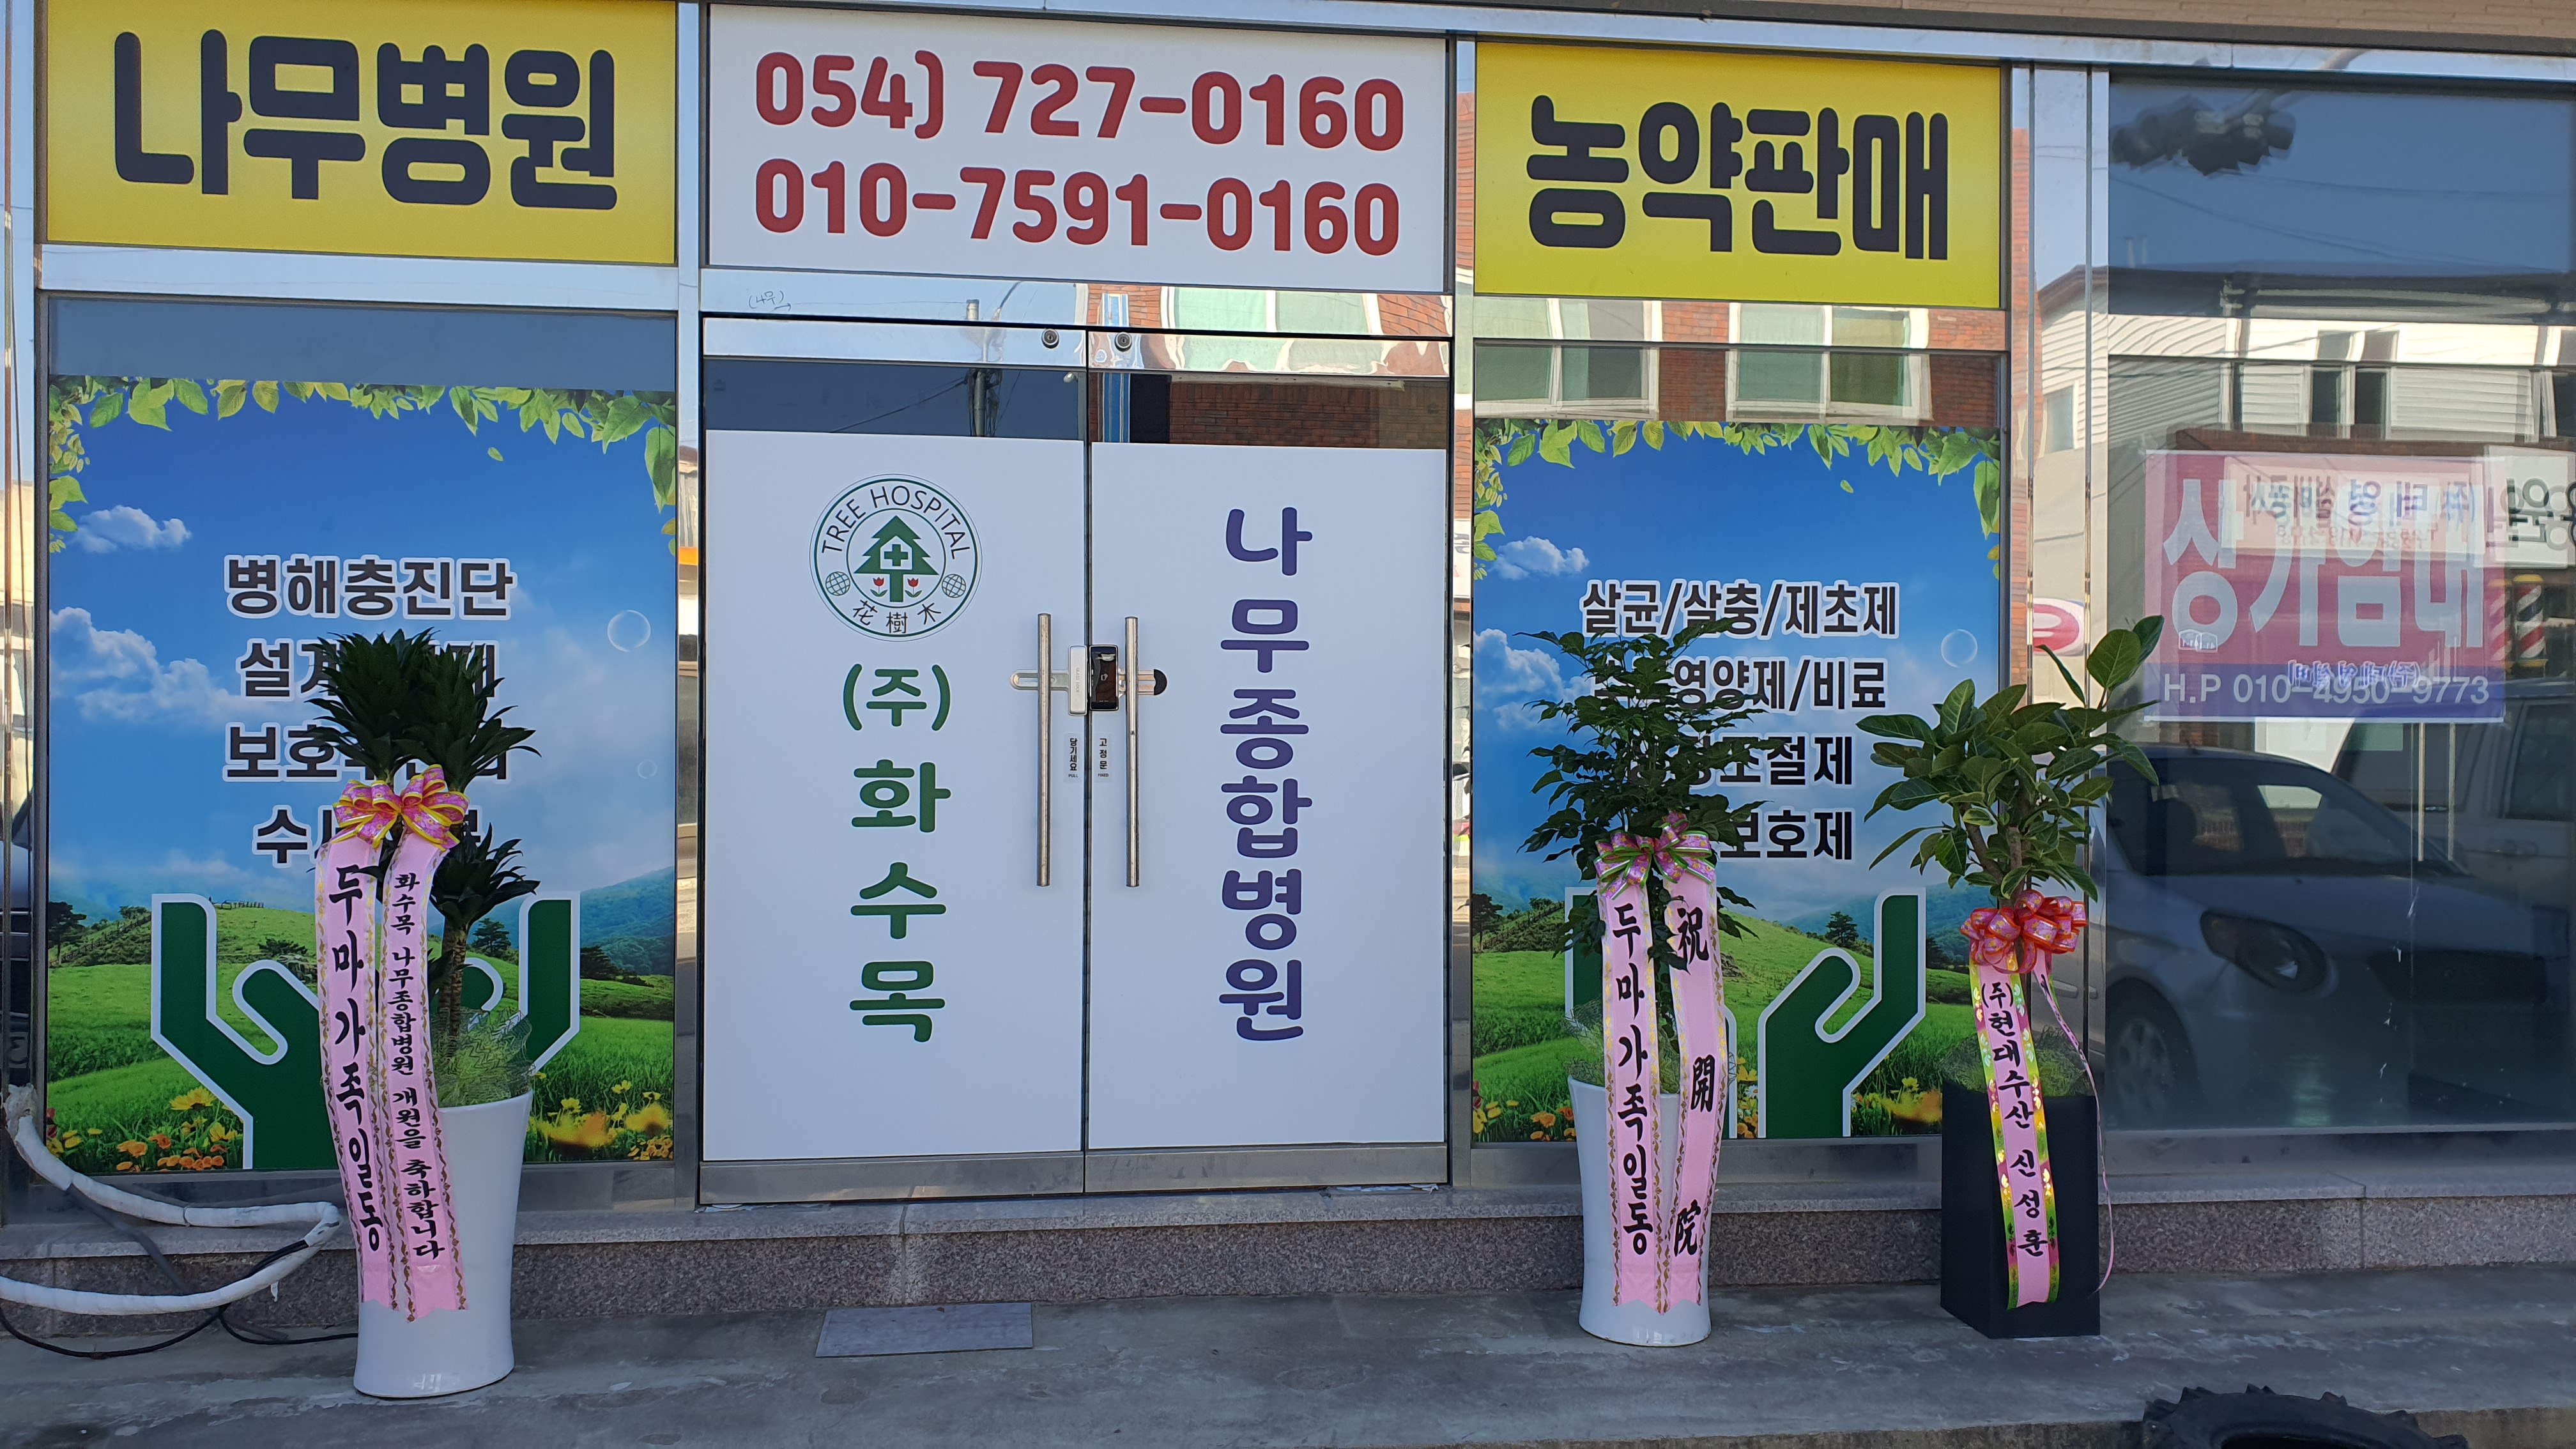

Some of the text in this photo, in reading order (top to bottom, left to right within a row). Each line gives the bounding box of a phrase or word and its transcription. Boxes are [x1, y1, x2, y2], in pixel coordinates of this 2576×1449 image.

[114, 29, 618, 210] 나무병원
[756, 50, 1404, 151] 054) 727-0160
[756, 158, 1400, 256] 010-7591-0160
[1526, 95, 1948, 261] 농약판매
[821, 485, 970, 560] TREE HOSPITAL
[2163, 479, 2483, 648] 상가임대
[227, 558, 514, 617] 병해충진단
[852, 599, 942, 634] 花樹木
[1582, 582, 1896, 636] 살균/살충/제초제
[2164, 673, 2221, 703] H.P
[1069, 737, 1078, 771] 당기세요
[1099, 737, 1108, 770] 고정문
[1218, 507, 1313, 1041] 나무종합병원
[386, 872, 446, 1261] 화수목 나무종합병원 개원을 축하합니다
[2009, 1149, 2049, 1257] 신성훈
